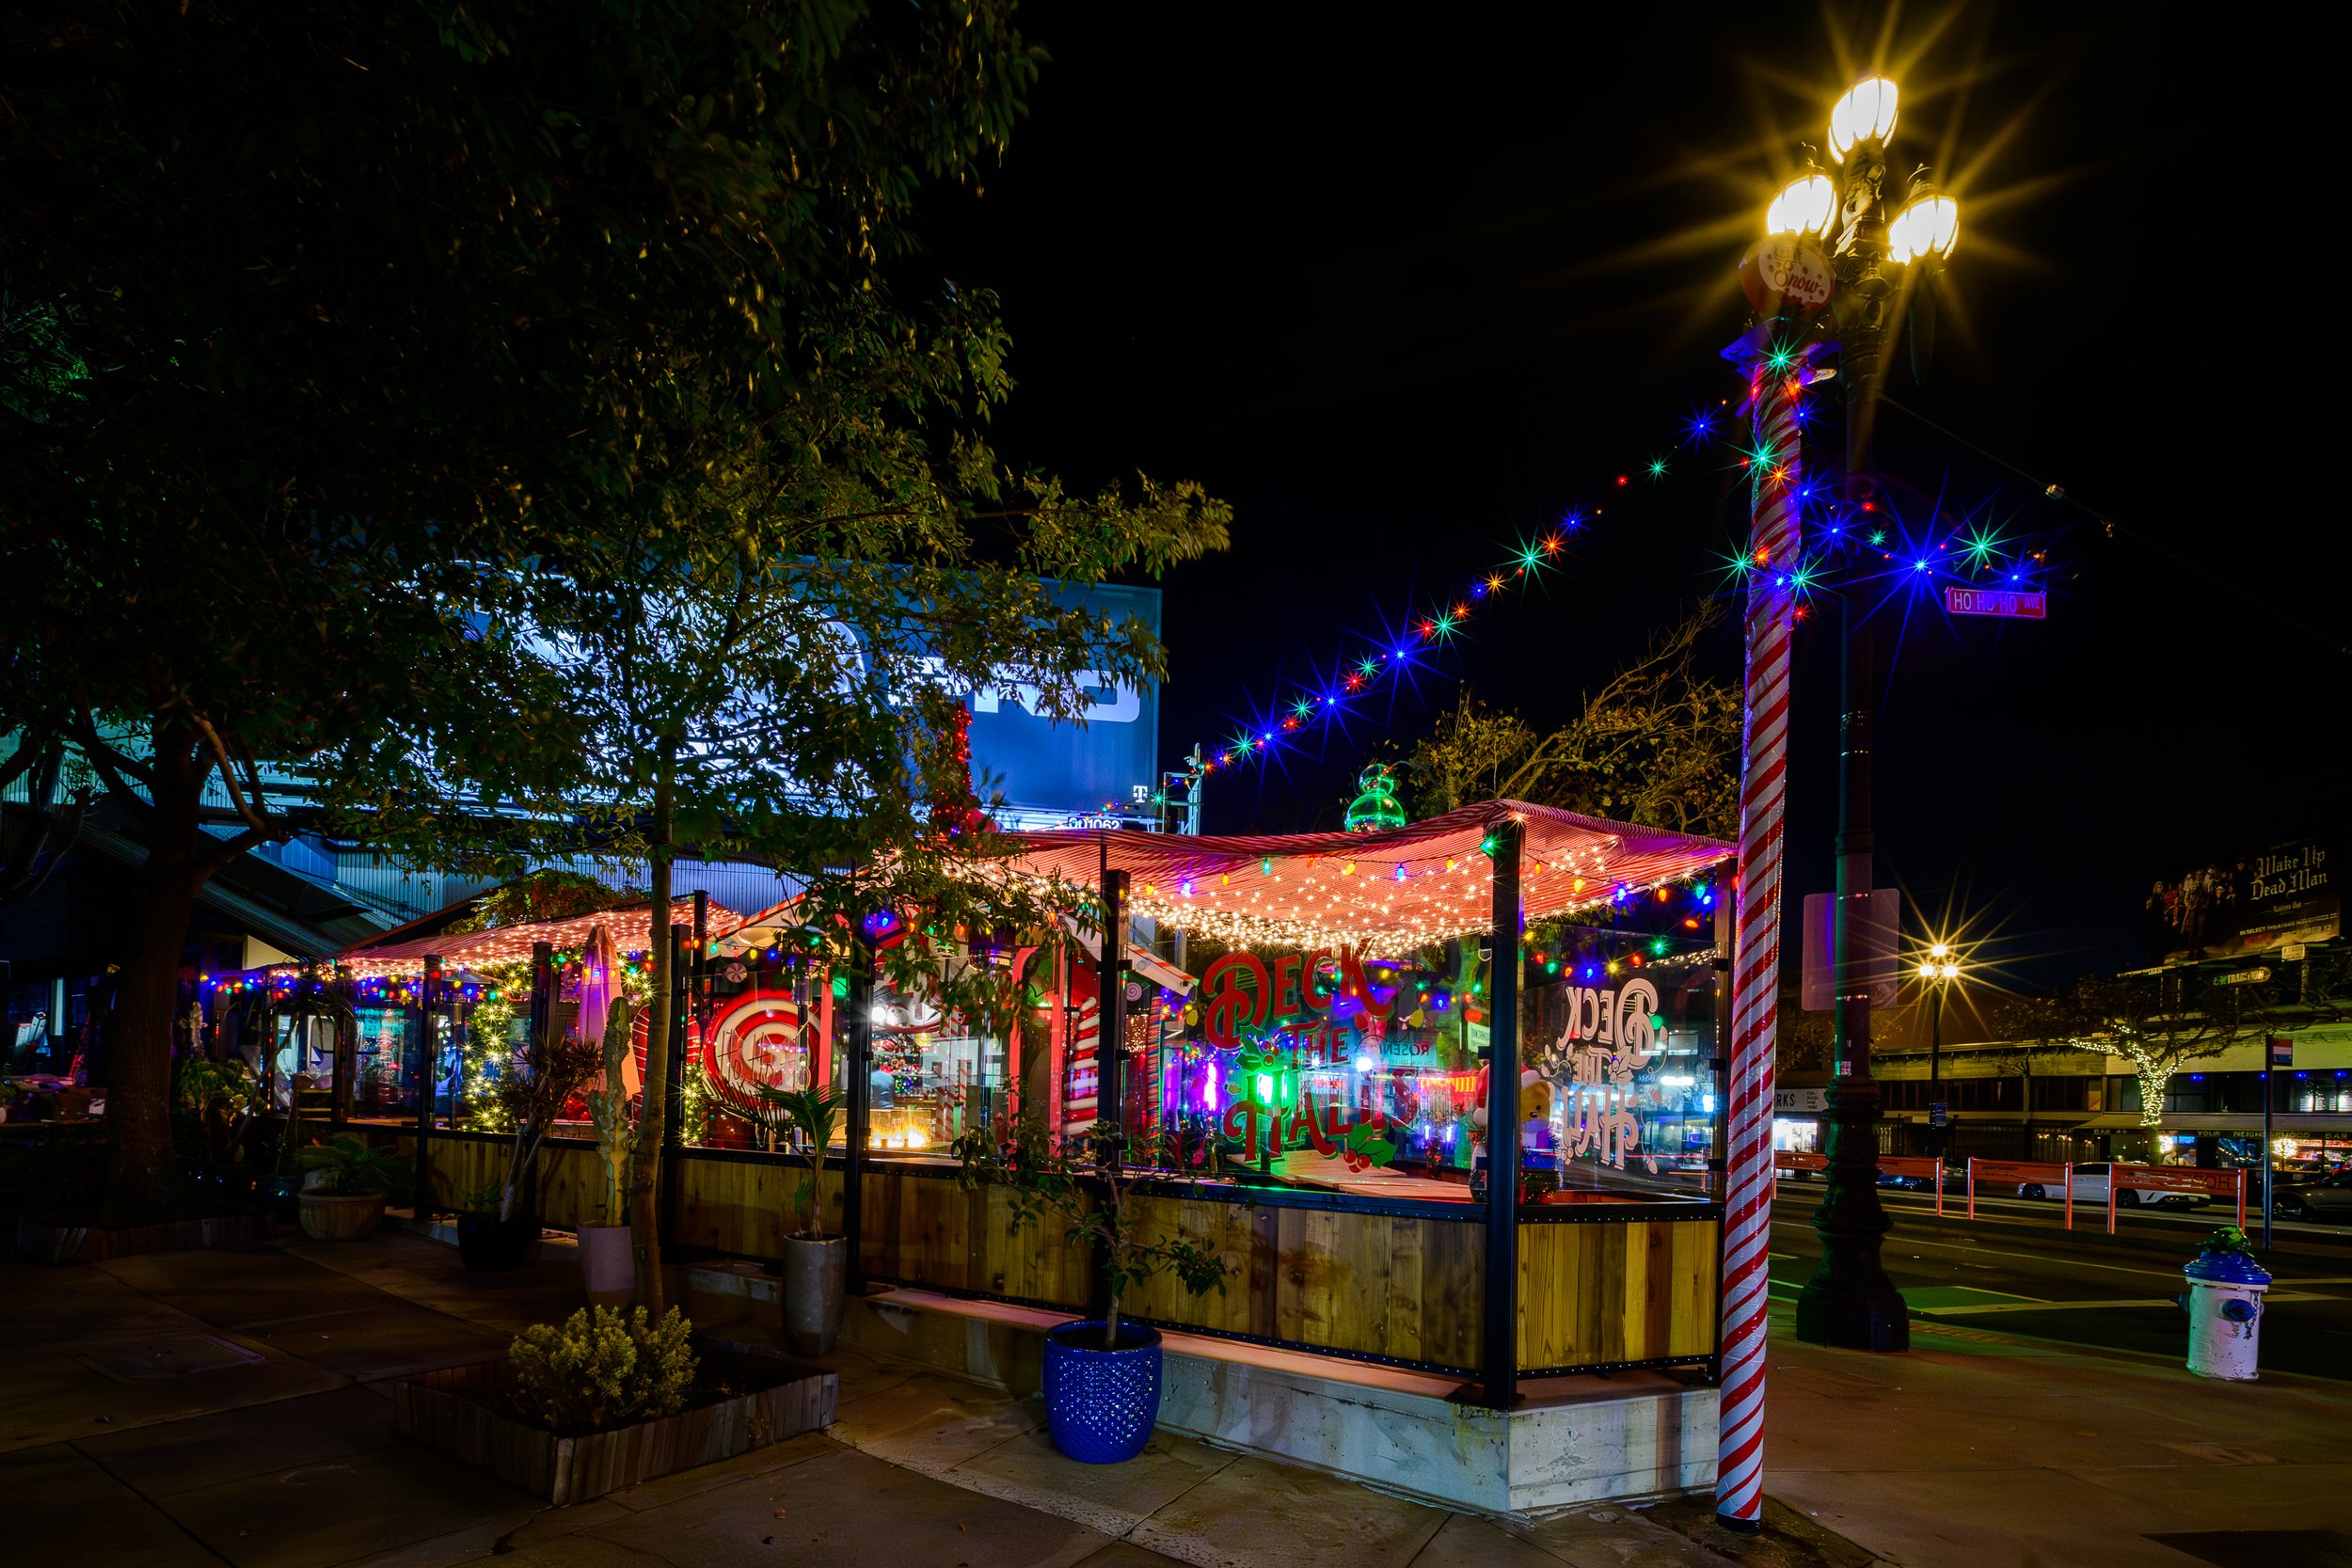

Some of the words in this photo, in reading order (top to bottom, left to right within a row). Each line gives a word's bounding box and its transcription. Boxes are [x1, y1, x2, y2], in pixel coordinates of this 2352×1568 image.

[1773, 260, 1821, 293] Snow
[1953, 592, 1972, 610] HO
[1977, 593, 1994, 611] HO
[1999, 594, 2018, 613] HO
[2024, 596, 2041, 610] AVE
[2255, 854, 2299, 879] Wake
[2301, 845, 2326, 868] Up
[2249, 877, 2286, 901] Dead
[2286, 867, 2328, 899] Man
[2246, 927, 2266, 935] SELECT
[1202, 937, 1395, 1053] DECK
[1272, 1019, 1351, 1070] THE
[1774, 1093, 1795, 1107] RKS
